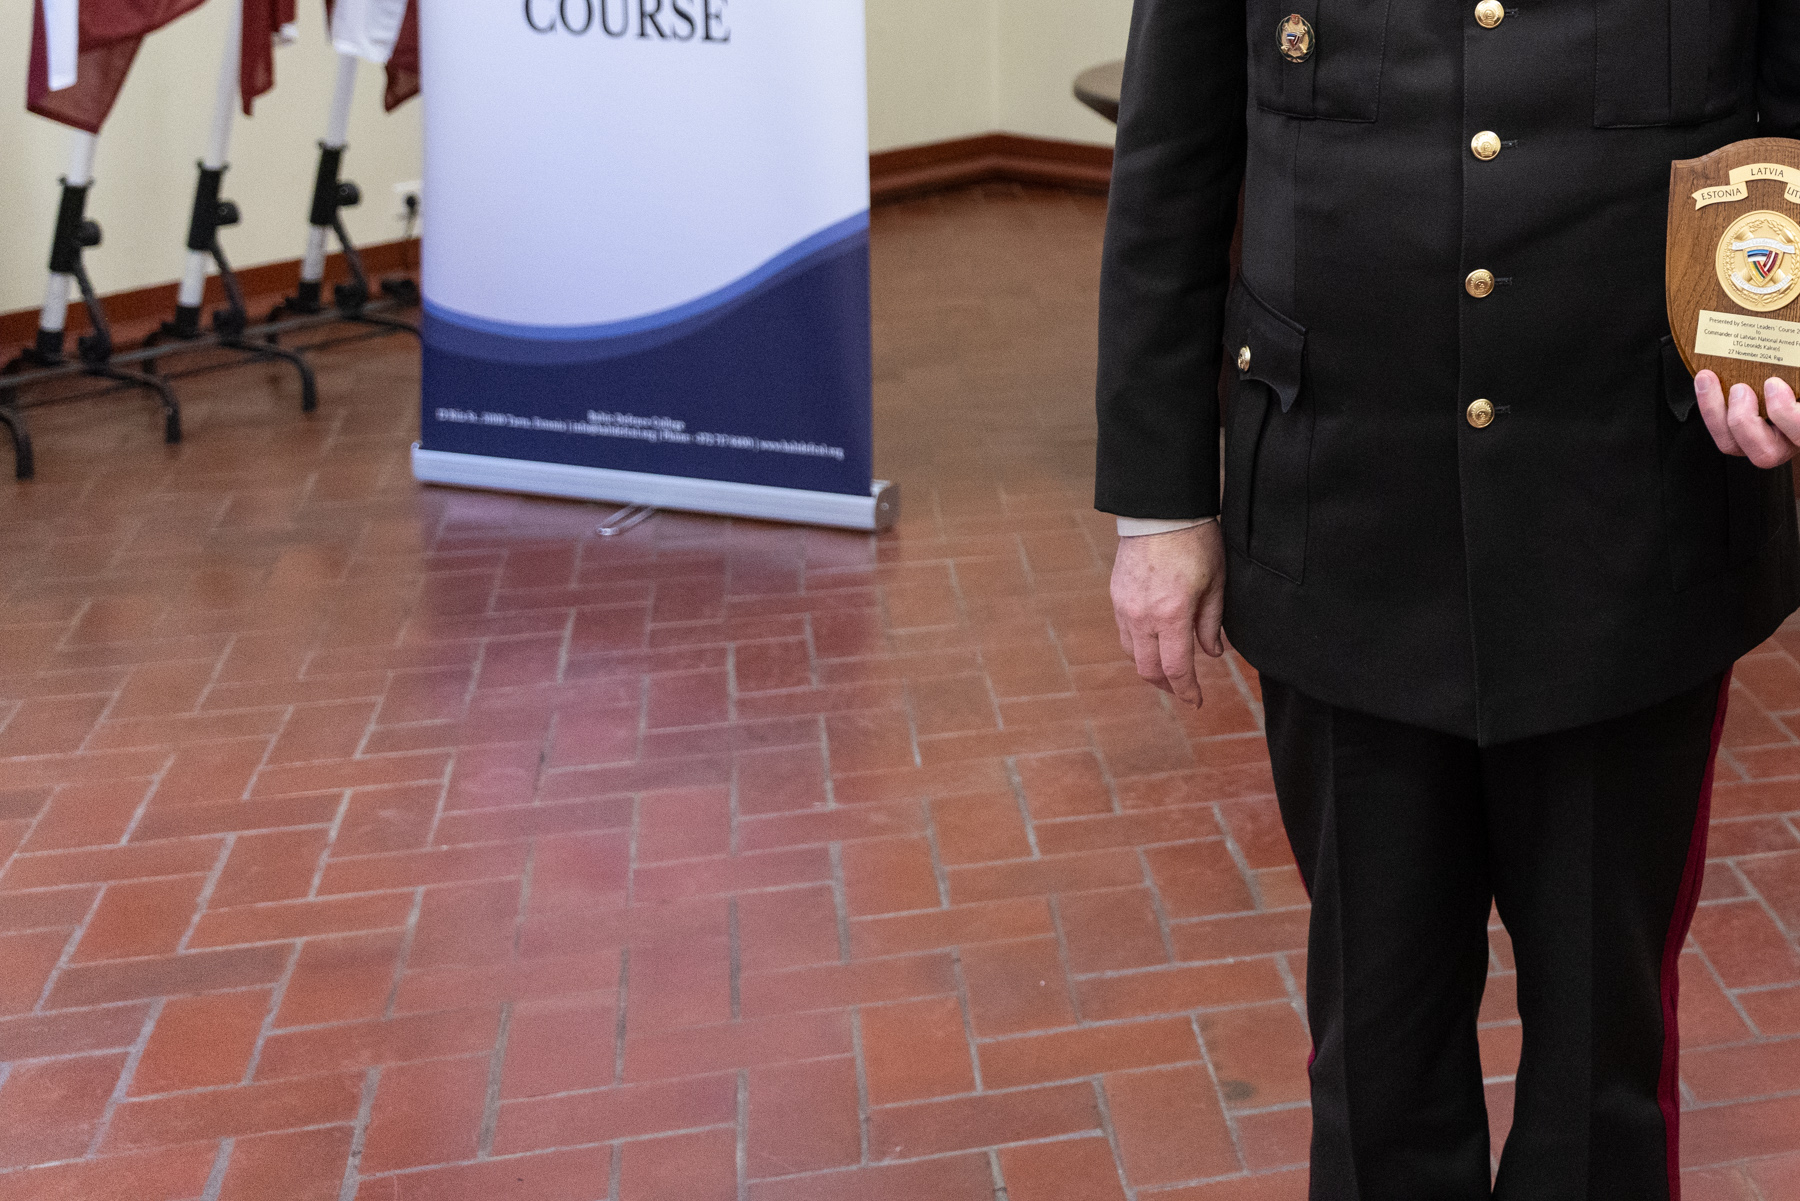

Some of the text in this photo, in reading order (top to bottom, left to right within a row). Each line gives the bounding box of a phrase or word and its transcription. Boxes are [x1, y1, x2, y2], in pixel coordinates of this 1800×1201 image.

[1750, 167, 1784, 178] LATVIA
[1701, 187, 1742, 201] ESTONIA
[1709, 317, 1733, 326] Presented
[1778, 326, 1795, 334] Course
[1704, 329, 1732, 338] Commander
[1758, 336, 1778, 344] National
[1735, 350, 1758, 358] November
